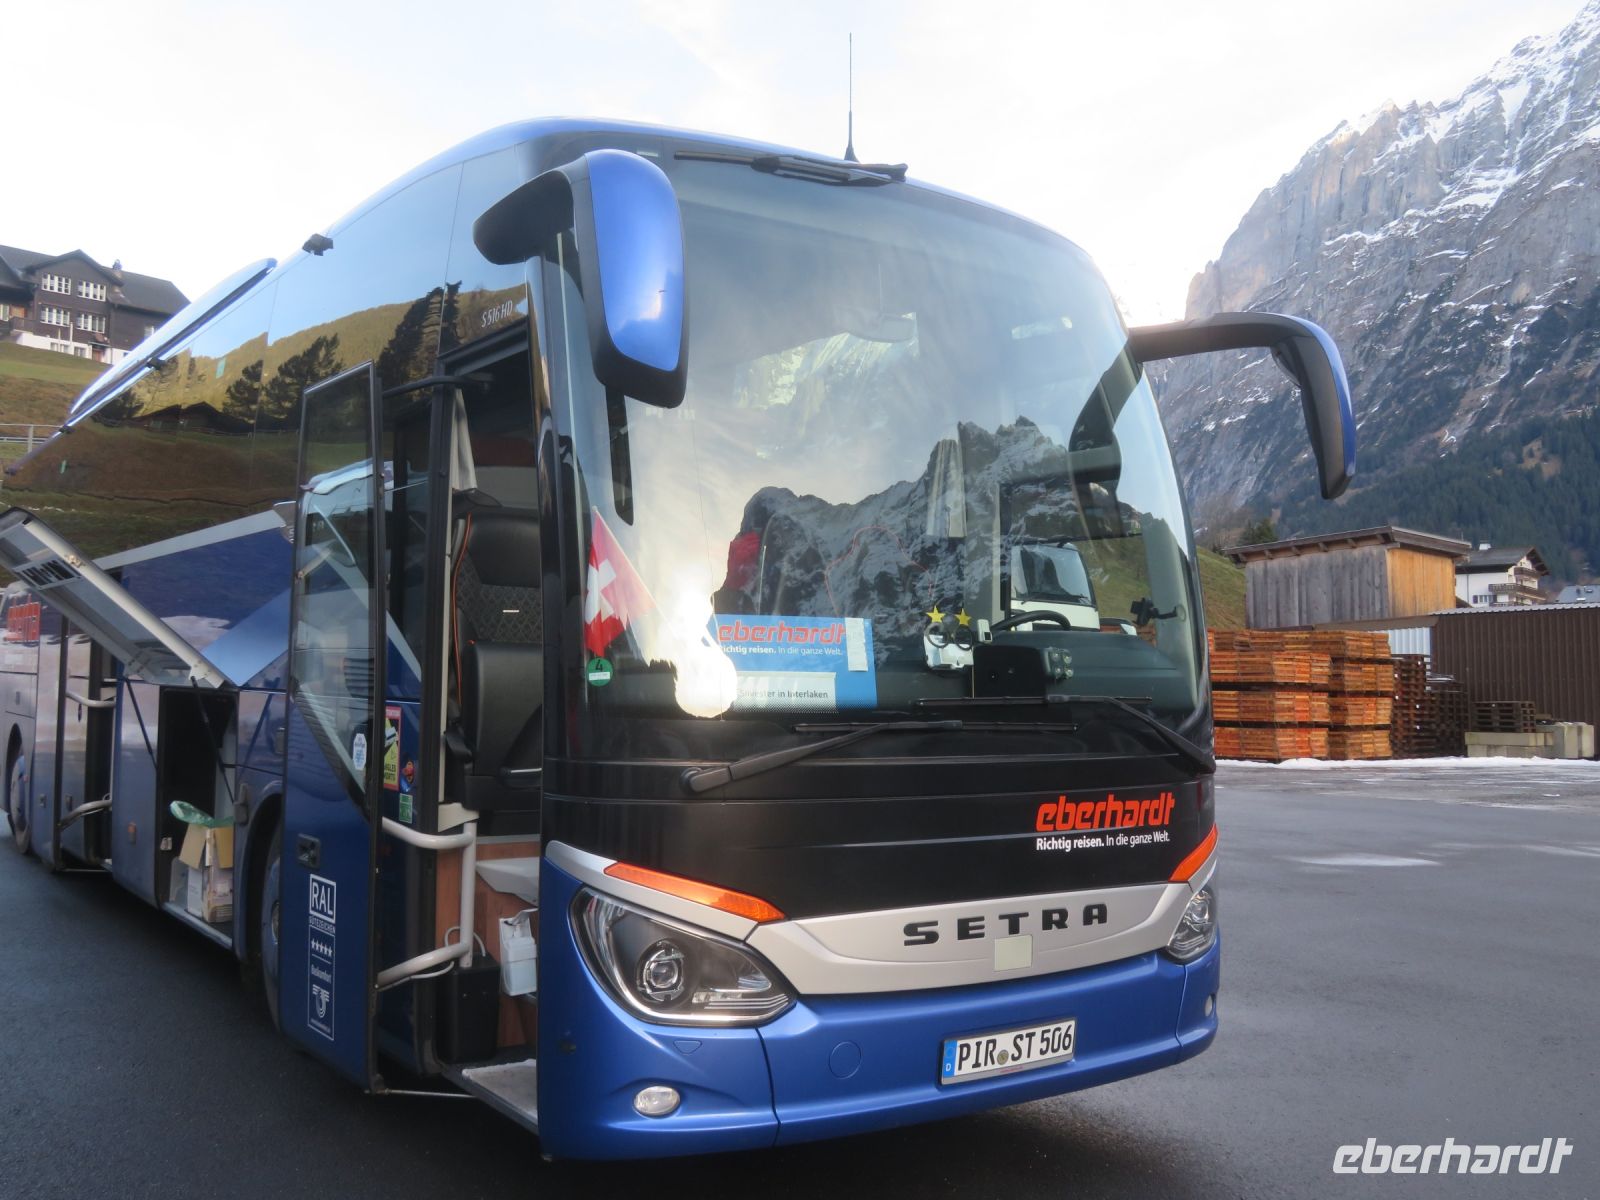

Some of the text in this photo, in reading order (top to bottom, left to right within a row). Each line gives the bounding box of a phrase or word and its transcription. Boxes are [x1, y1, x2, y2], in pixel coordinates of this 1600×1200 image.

[481, 311, 487, 328] S
[501, 300, 513, 319] HD
[718, 619, 846, 644] eberhardt
[720, 645, 747, 656] ichtig
[748, 645, 776, 655] reisen.
[778, 646, 786, 654] In
[800, 647, 823, 657] ganze
[824, 647, 843, 656] Welt.
[595, 659, 603, 672] 4
[777, 689, 786, 698] in
[787, 689, 828, 699] Interlaken
[1036, 792, 1175, 832] eberhardt
[1036, 830, 1170, 852] Richtig reisen. In die ganze Welt.
[311, 881, 334, 915] RAL
[903, 903, 1108, 946] SETRA
[957, 1024, 1073, 1072] PIR ST 506
[945, 1063, 952, 1072] D
